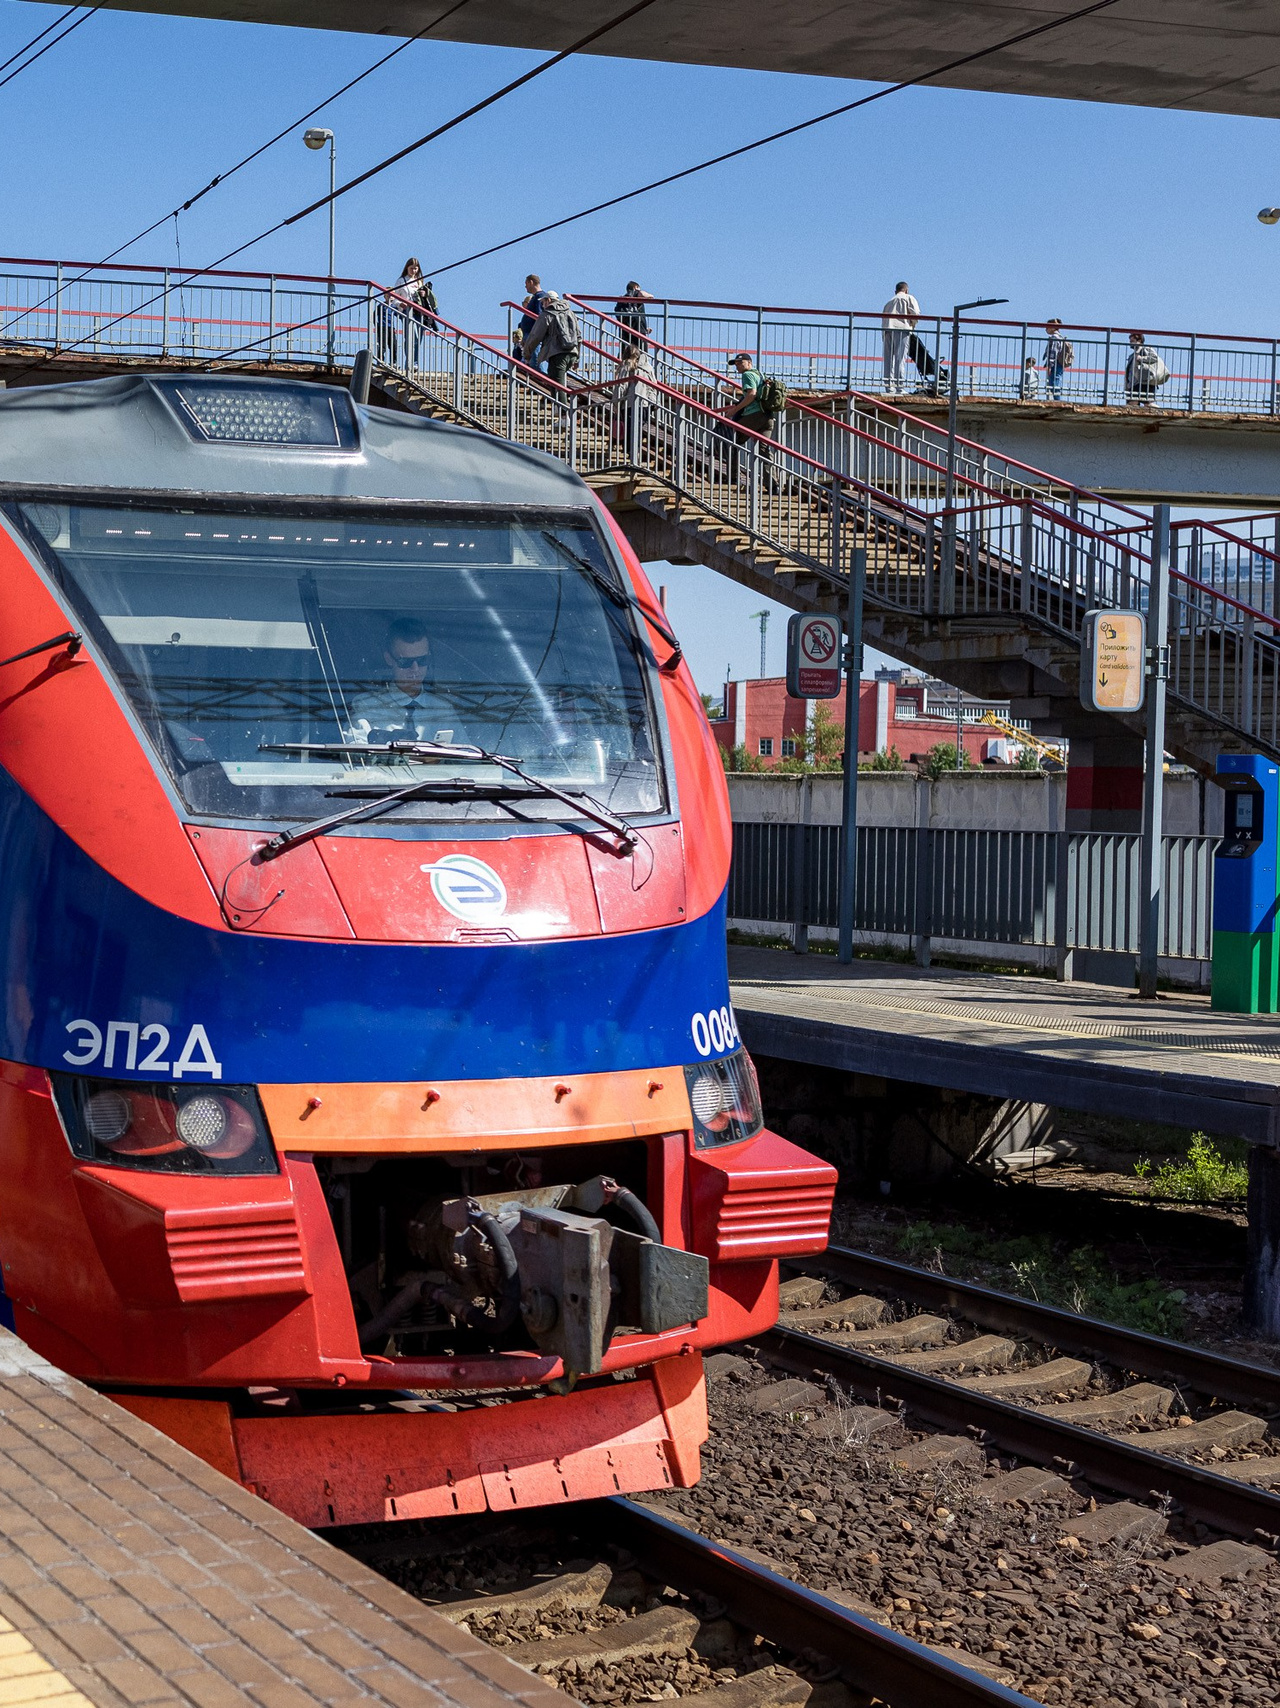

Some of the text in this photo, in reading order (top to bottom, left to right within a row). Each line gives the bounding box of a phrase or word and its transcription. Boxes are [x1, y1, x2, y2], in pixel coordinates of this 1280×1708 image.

[1100, 643, 1136, 652] Приложить
[1100, 655, 1117, 663] карту
[691, 1001, 740, 1057] 0084
[62, 1018, 222, 1080] ЭП2Д
